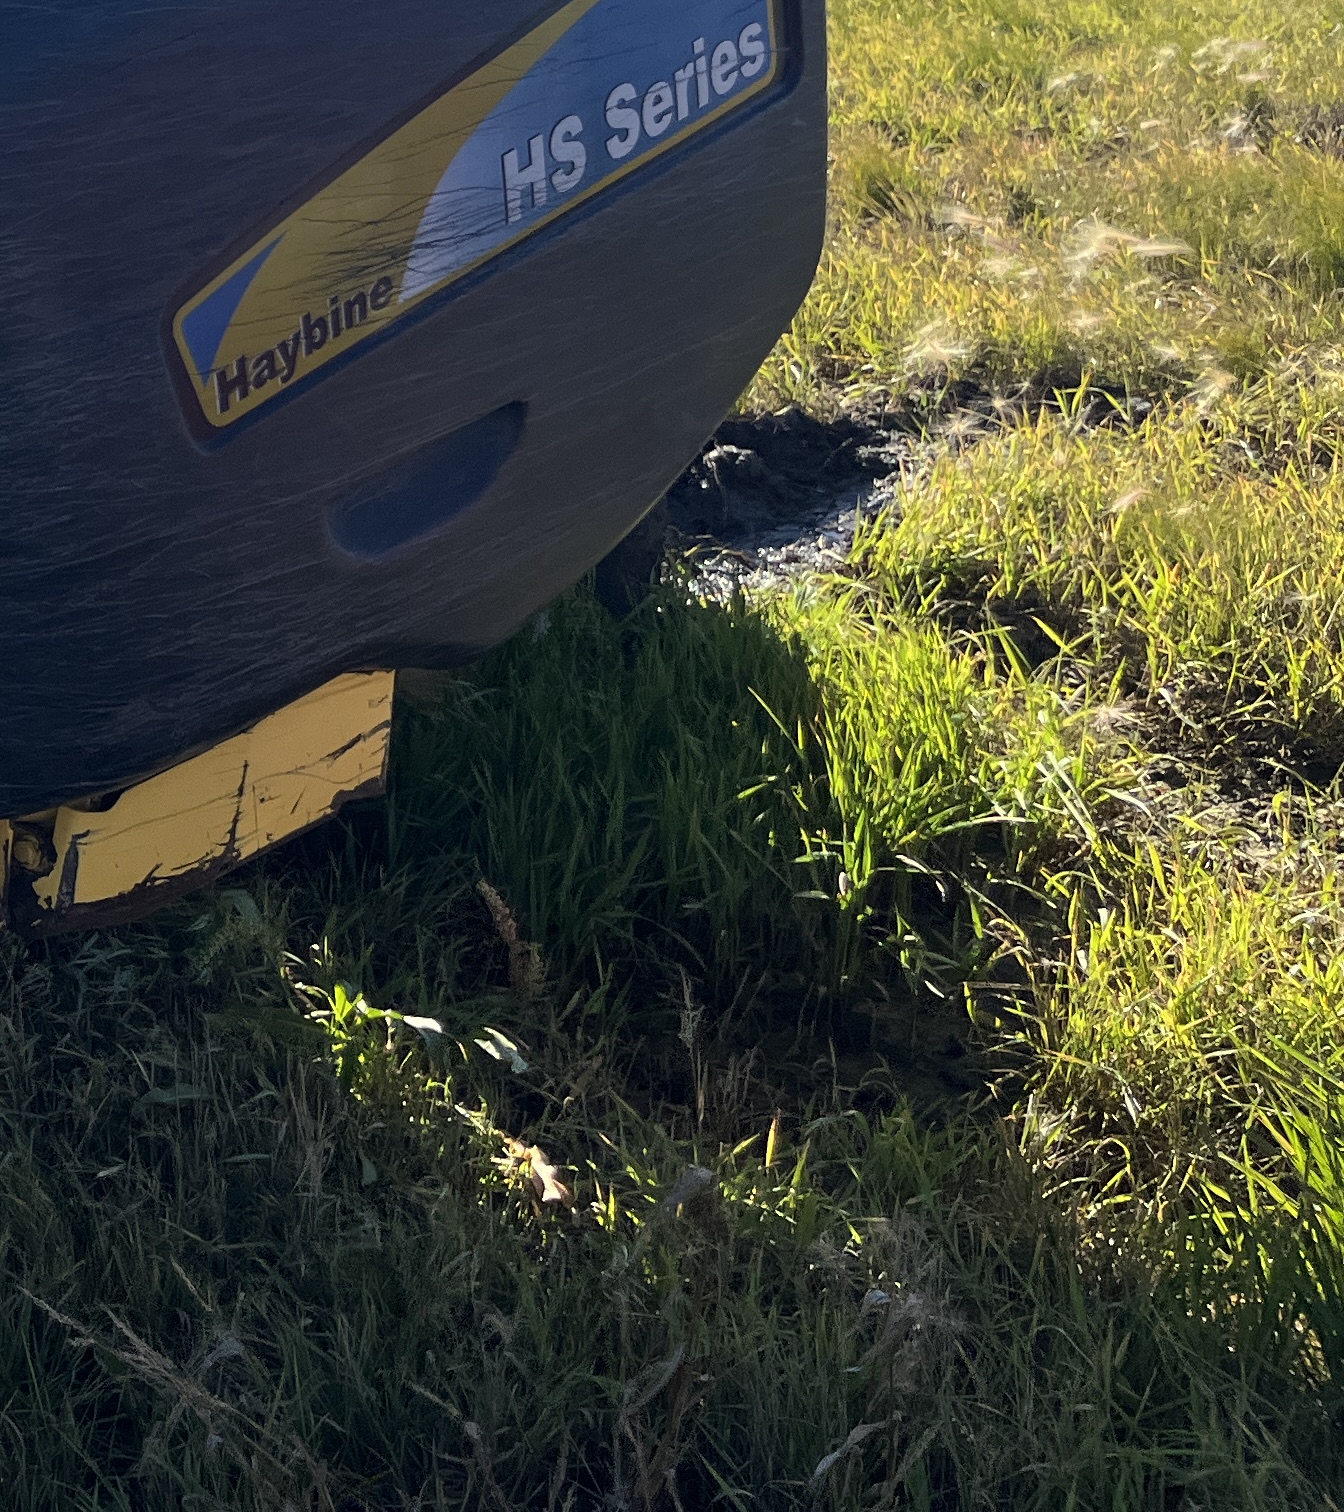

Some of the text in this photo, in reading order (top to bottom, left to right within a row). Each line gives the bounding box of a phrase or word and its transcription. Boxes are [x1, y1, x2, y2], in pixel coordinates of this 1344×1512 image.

[501, 21, 766, 225] HS Series
[213, 275, 393, 416] Haybine
